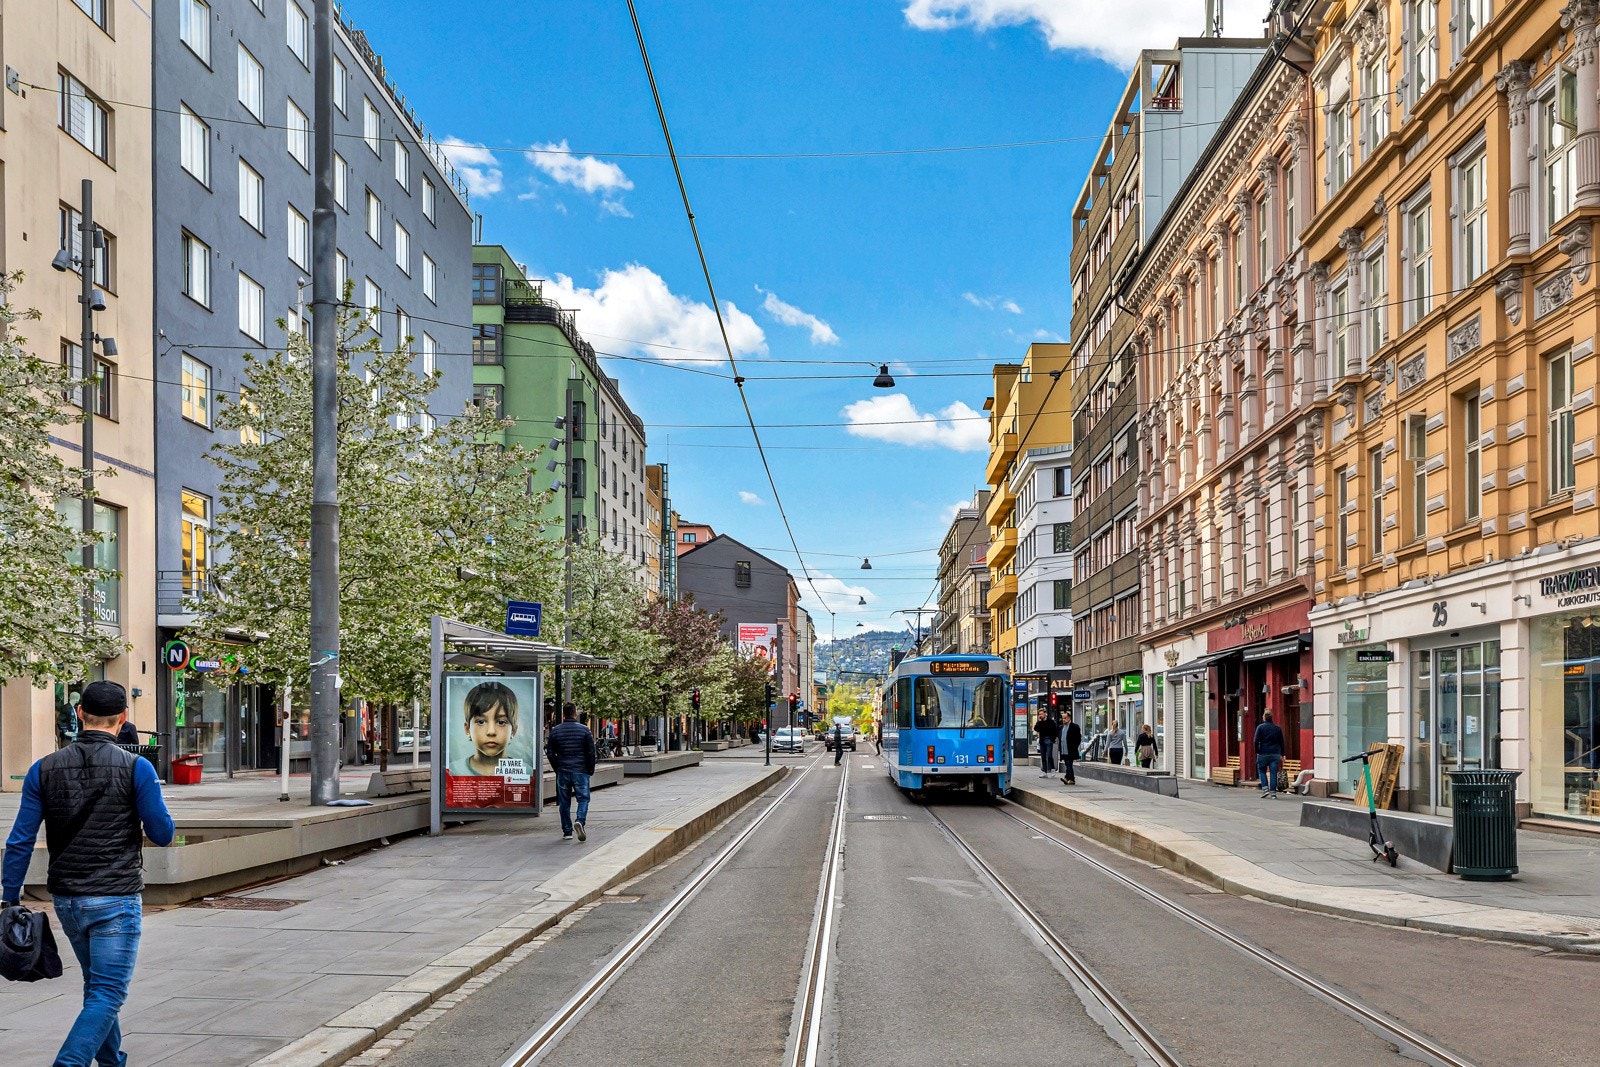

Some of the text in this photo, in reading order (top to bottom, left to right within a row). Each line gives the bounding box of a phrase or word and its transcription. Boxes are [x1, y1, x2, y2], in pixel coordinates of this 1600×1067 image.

[1539, 566, 1600, 596] TRAKTØREN
[1432, 601, 1448, 627] 25
[170, 649, 183, 662] N
[955, 754, 969, 764] 131
[496, 767, 503, 775] PÅ
